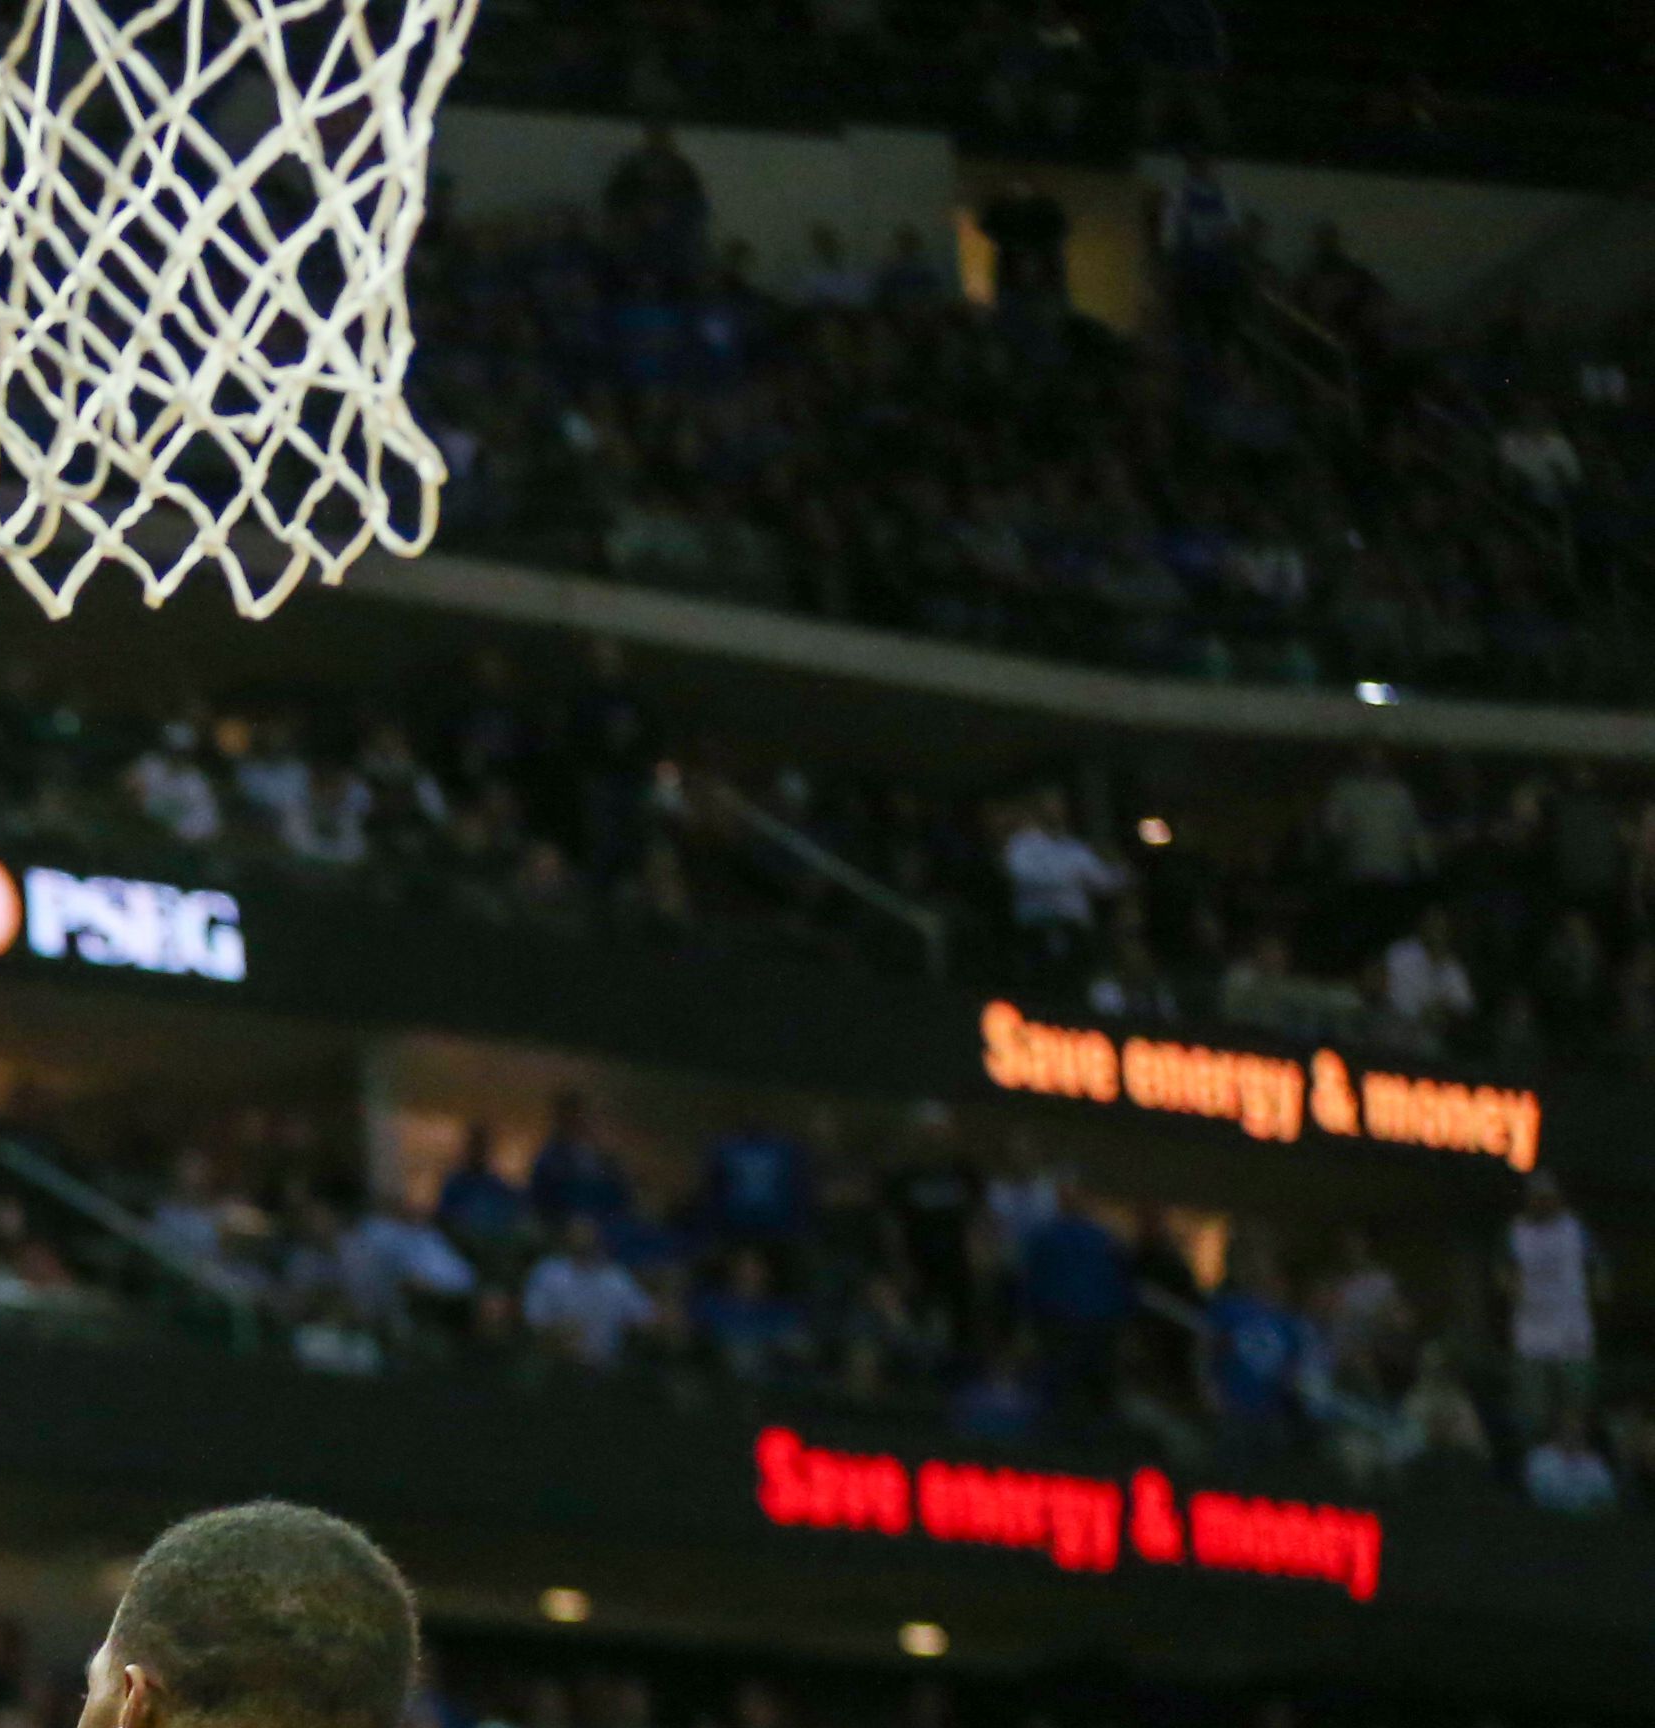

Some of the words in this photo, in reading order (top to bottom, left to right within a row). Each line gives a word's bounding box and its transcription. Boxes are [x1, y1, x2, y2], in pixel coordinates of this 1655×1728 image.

[26, 867, 246, 981] PSEG
[981, 1000, 1120, 1102] Save
[1121, 1037, 1305, 1142] energy
[1310, 1048, 1360, 1136] &
[1362, 1071, 1542, 1172] money
[755, 1427, 911, 1535] Save
[916, 1460, 1123, 1571] energy
[1130, 1467, 1184, 1562] &
[1190, 1491, 1382, 1600] money
